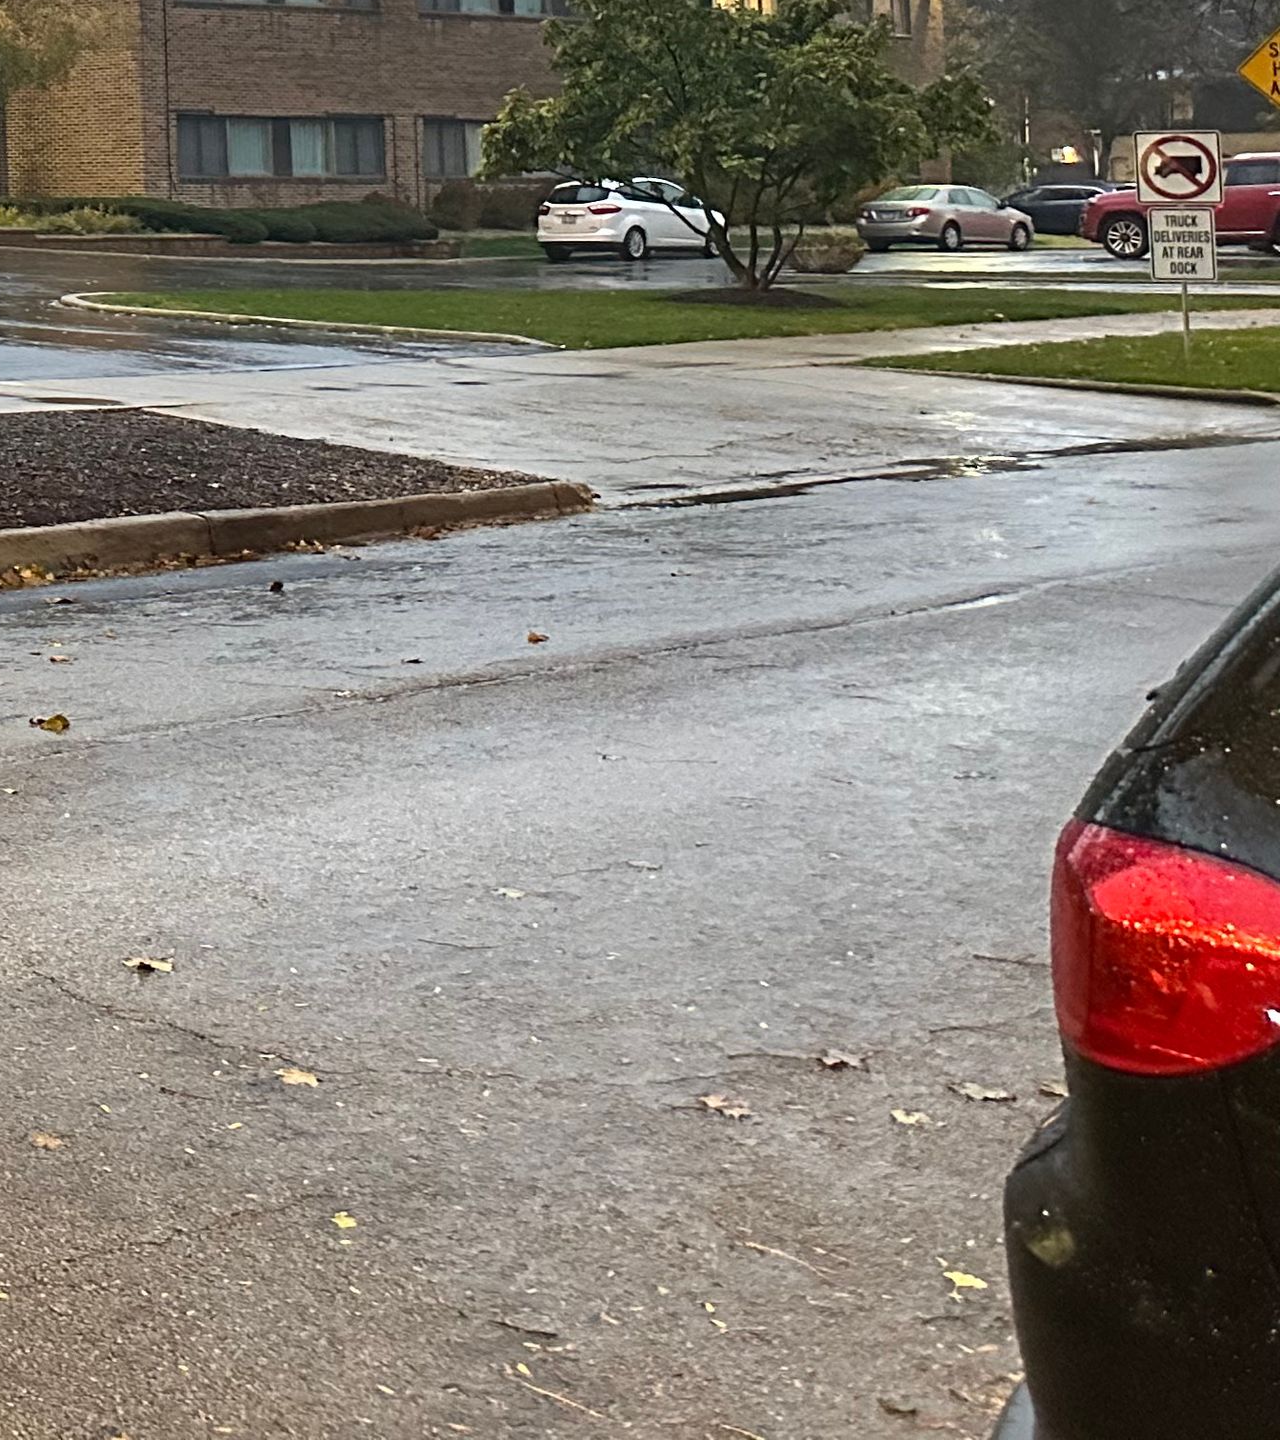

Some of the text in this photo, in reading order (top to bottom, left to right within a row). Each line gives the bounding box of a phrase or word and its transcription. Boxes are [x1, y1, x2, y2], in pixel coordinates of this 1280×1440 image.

[1164, 215, 1198, 227] TRUCK
[1154, 230, 1210, 243] DELIVERIES
[1162, 246, 1204, 258] AT REAR
[1170, 262, 1197, 274] DOCK
